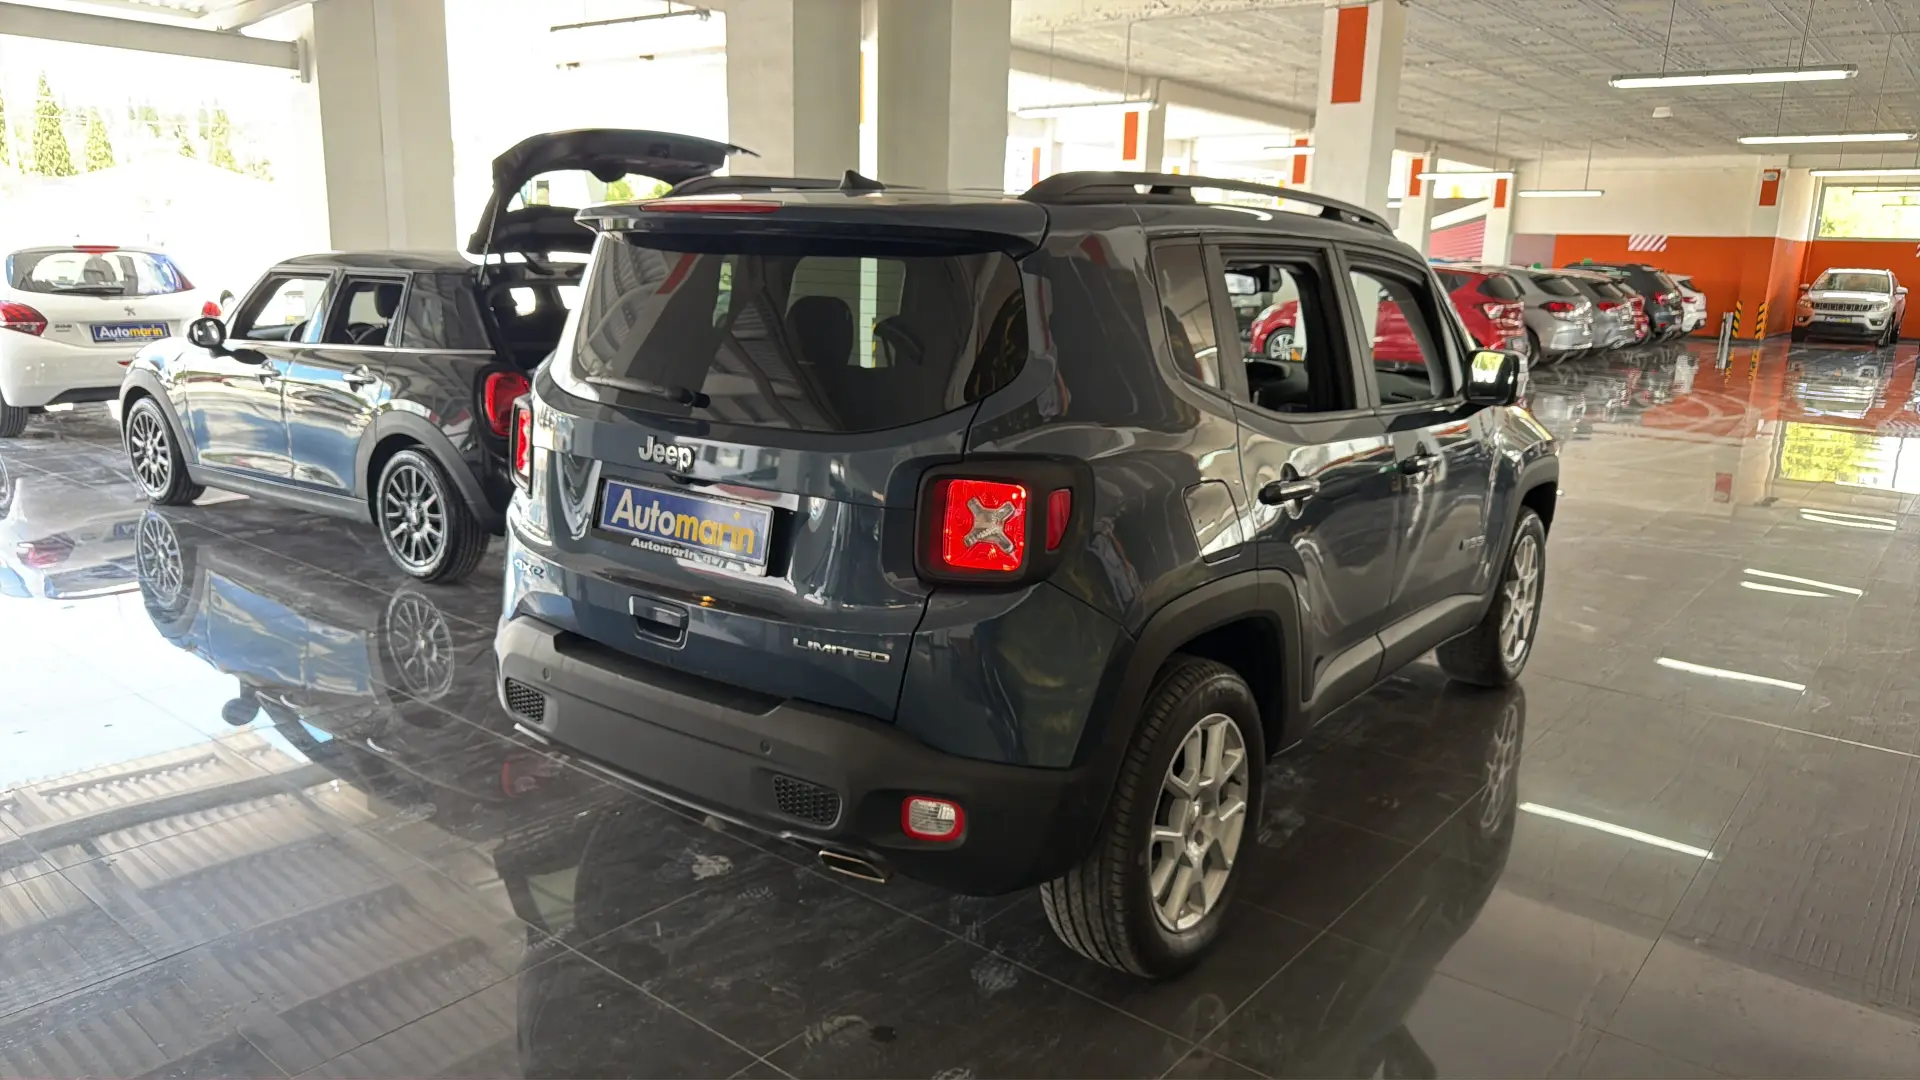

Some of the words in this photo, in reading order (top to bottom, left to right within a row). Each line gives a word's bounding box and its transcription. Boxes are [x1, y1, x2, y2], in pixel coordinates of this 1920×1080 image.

[100, 324, 163, 338] Automarin
[638, 435, 694, 471] Jeep
[611, 488, 755, 554] Automarin
[793, 637, 891, 663] LIMITED
